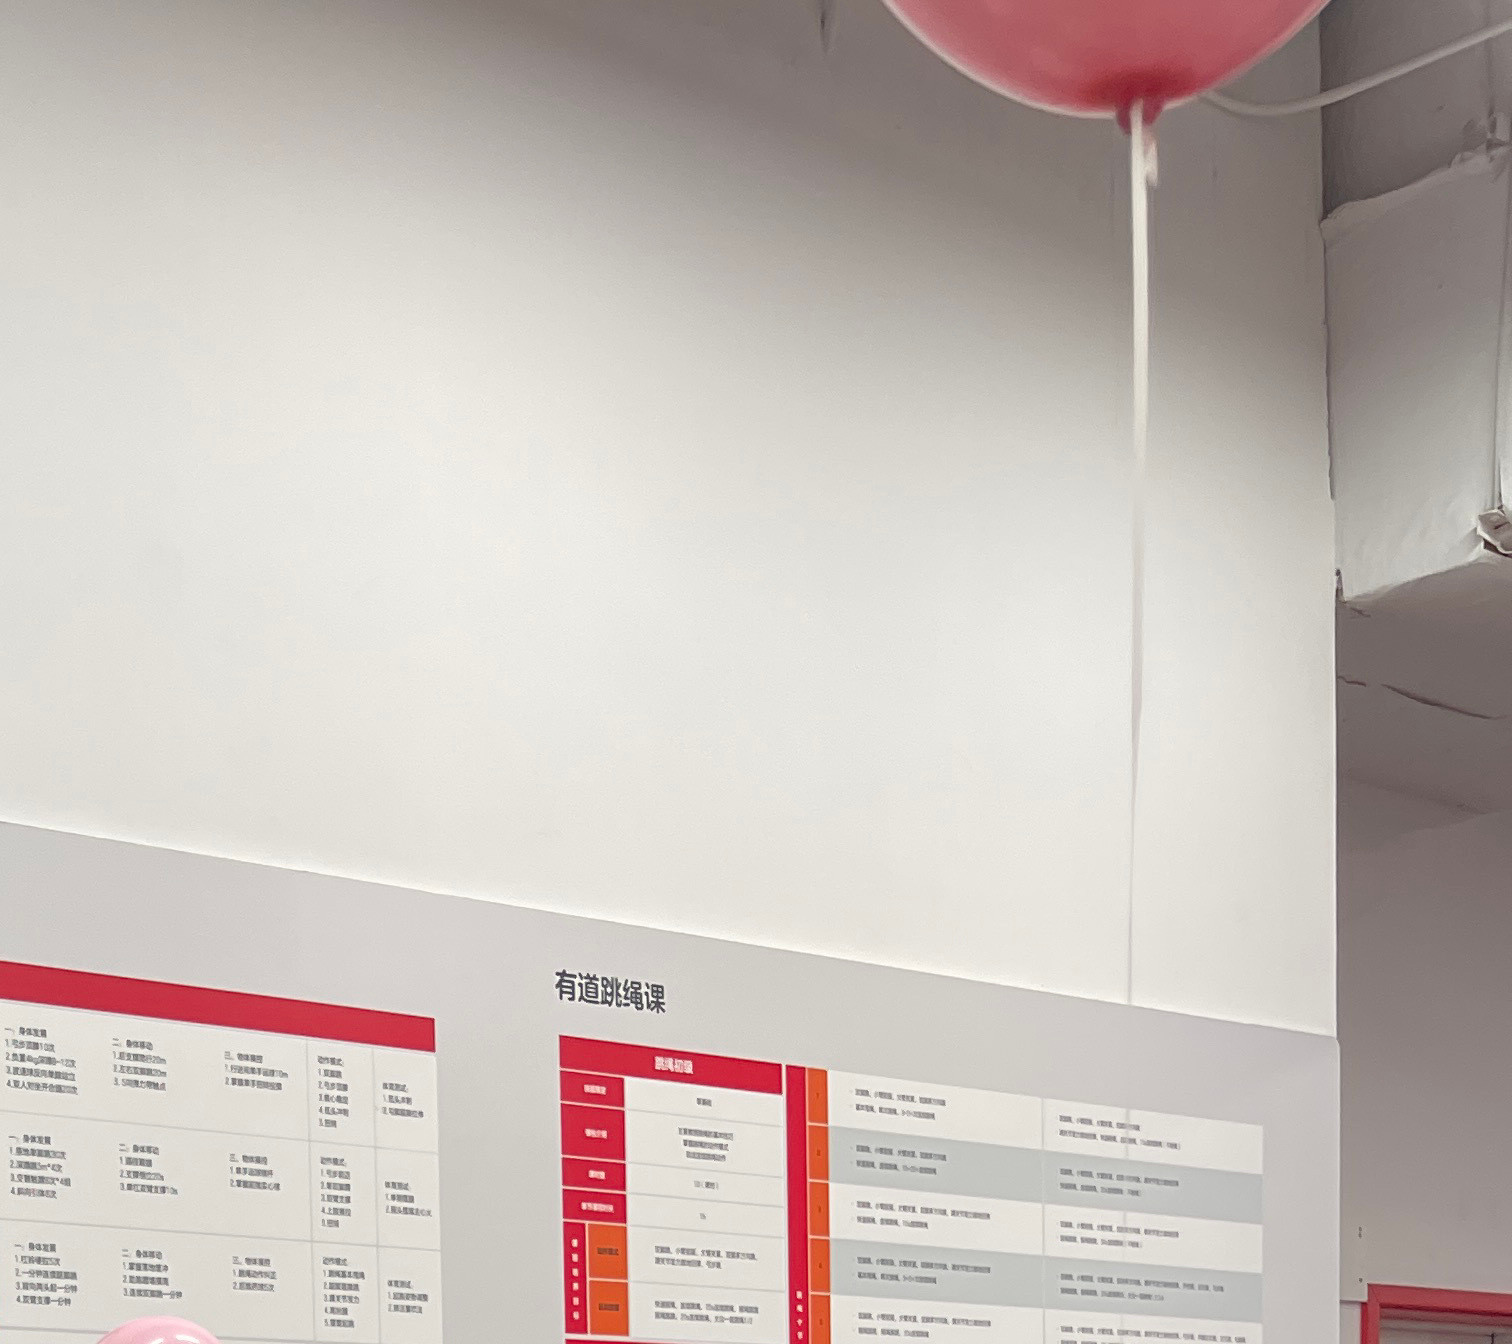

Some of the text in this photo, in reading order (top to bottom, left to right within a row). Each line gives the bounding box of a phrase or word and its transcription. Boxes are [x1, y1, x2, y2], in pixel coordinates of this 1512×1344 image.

[555, 969, 667, 1014] 有道跳绳课
